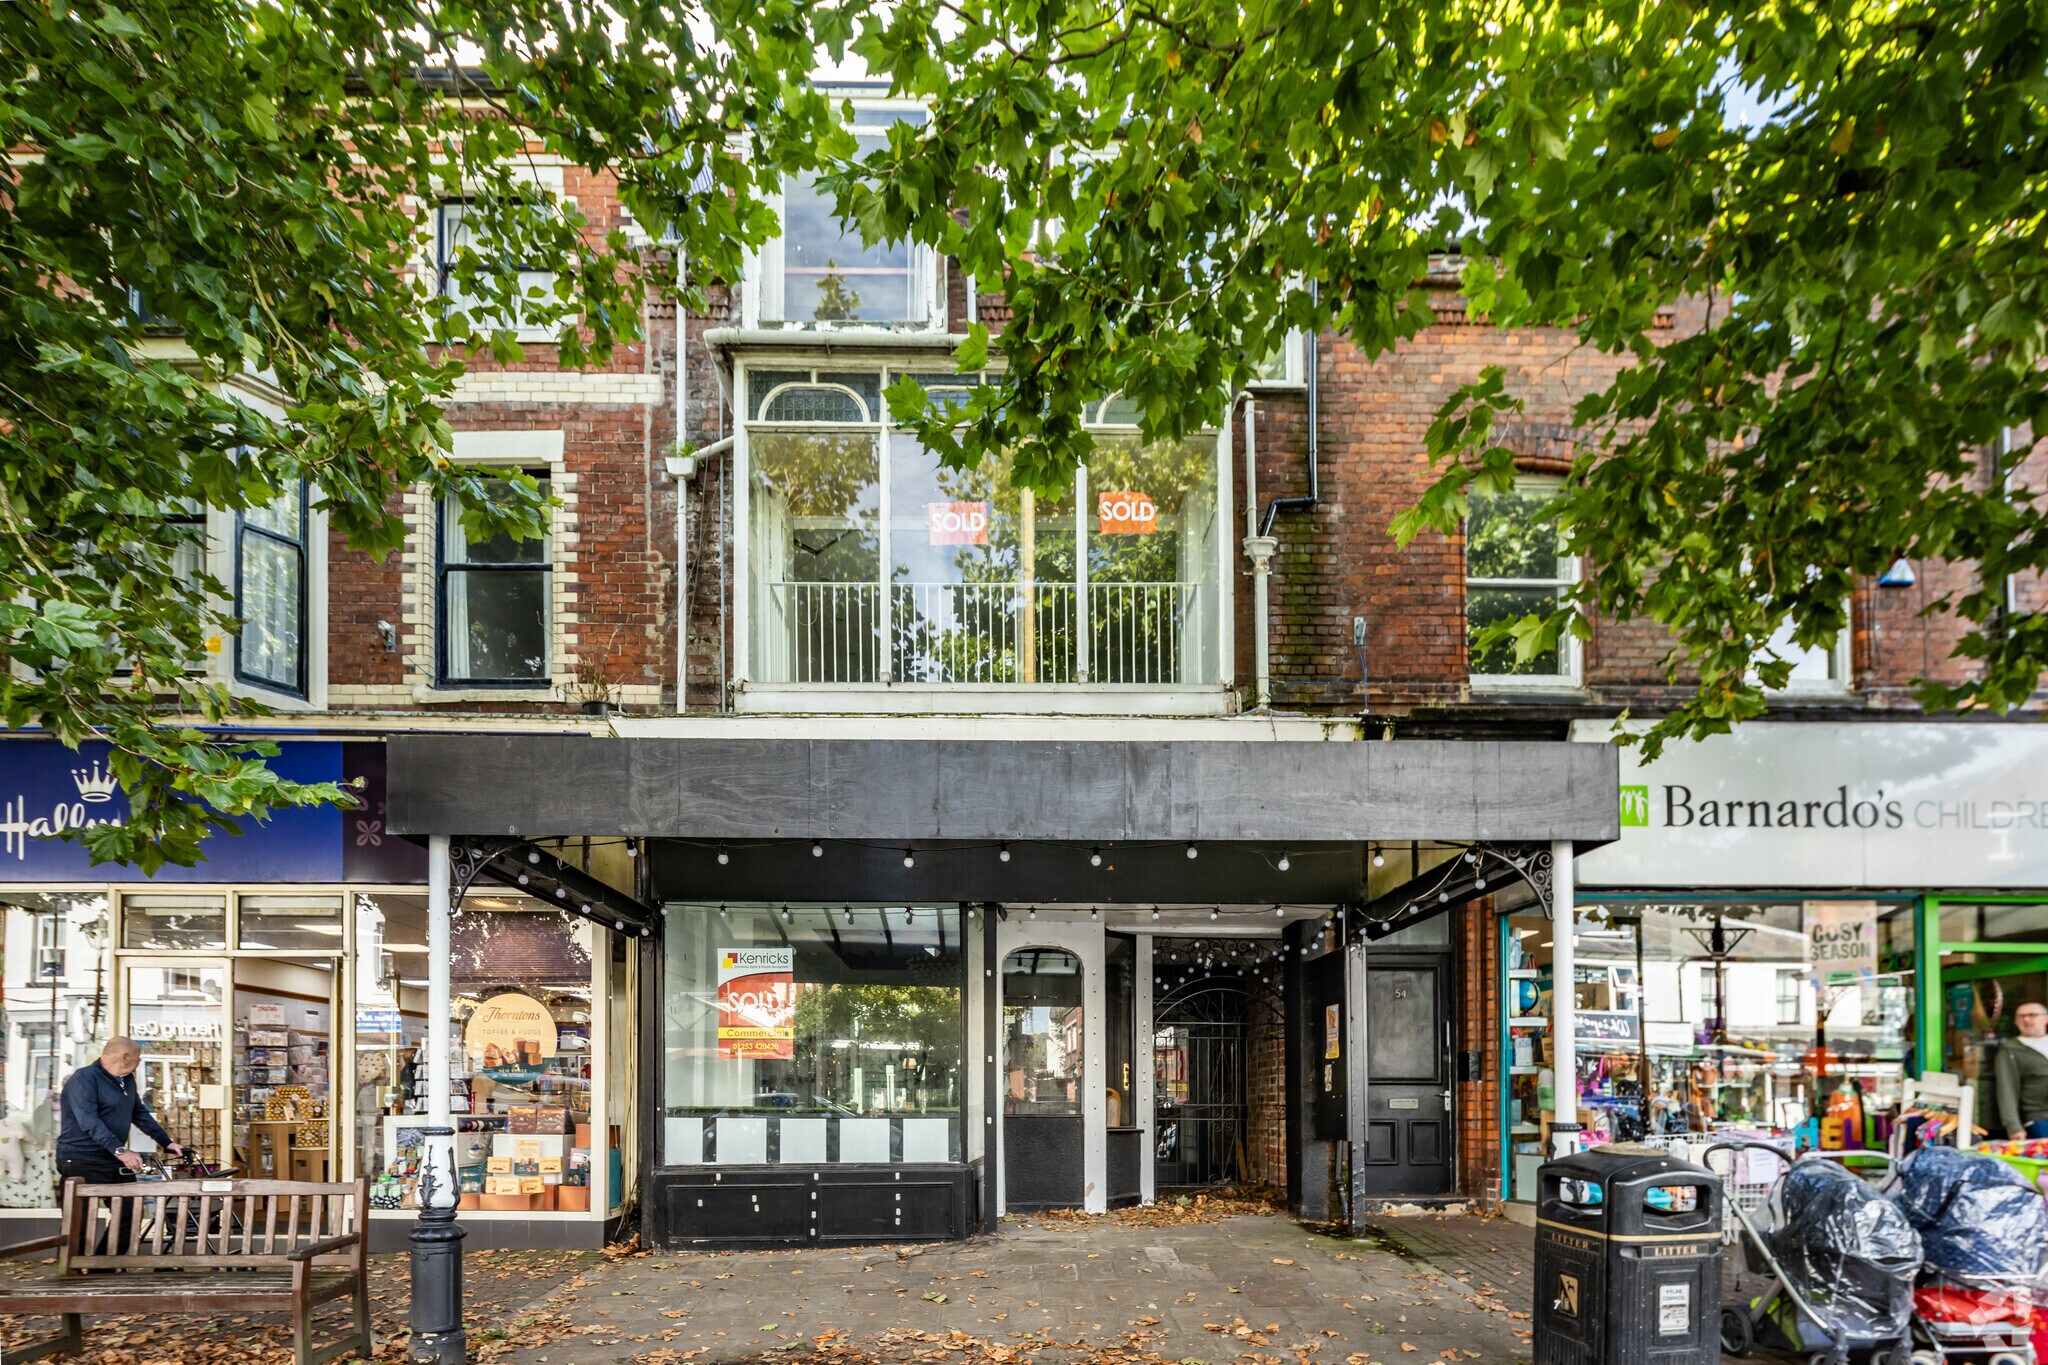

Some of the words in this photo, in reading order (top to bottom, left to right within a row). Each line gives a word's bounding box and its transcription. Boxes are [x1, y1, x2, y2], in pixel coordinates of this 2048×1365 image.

[1101, 501, 1155, 522] SOLD
[931, 512, 986, 533] SOLD
[1662, 784, 1904, 829] Barnardo's
[1914, 800, 2048, 829] CHILDRE
[1812, 922, 1863, 944] COSY
[739, 952, 789, 965] Kenricks
[1809, 942, 1872, 962] SEASON
[728, 991, 781, 1013] SOLD
[1394, 988, 1407, 998] 54
[482, 1006, 541, 1023] Thorntons
[1551, 1232, 1590, 1250] LITTER
[1654, 1245, 1698, 1257] LITTER
